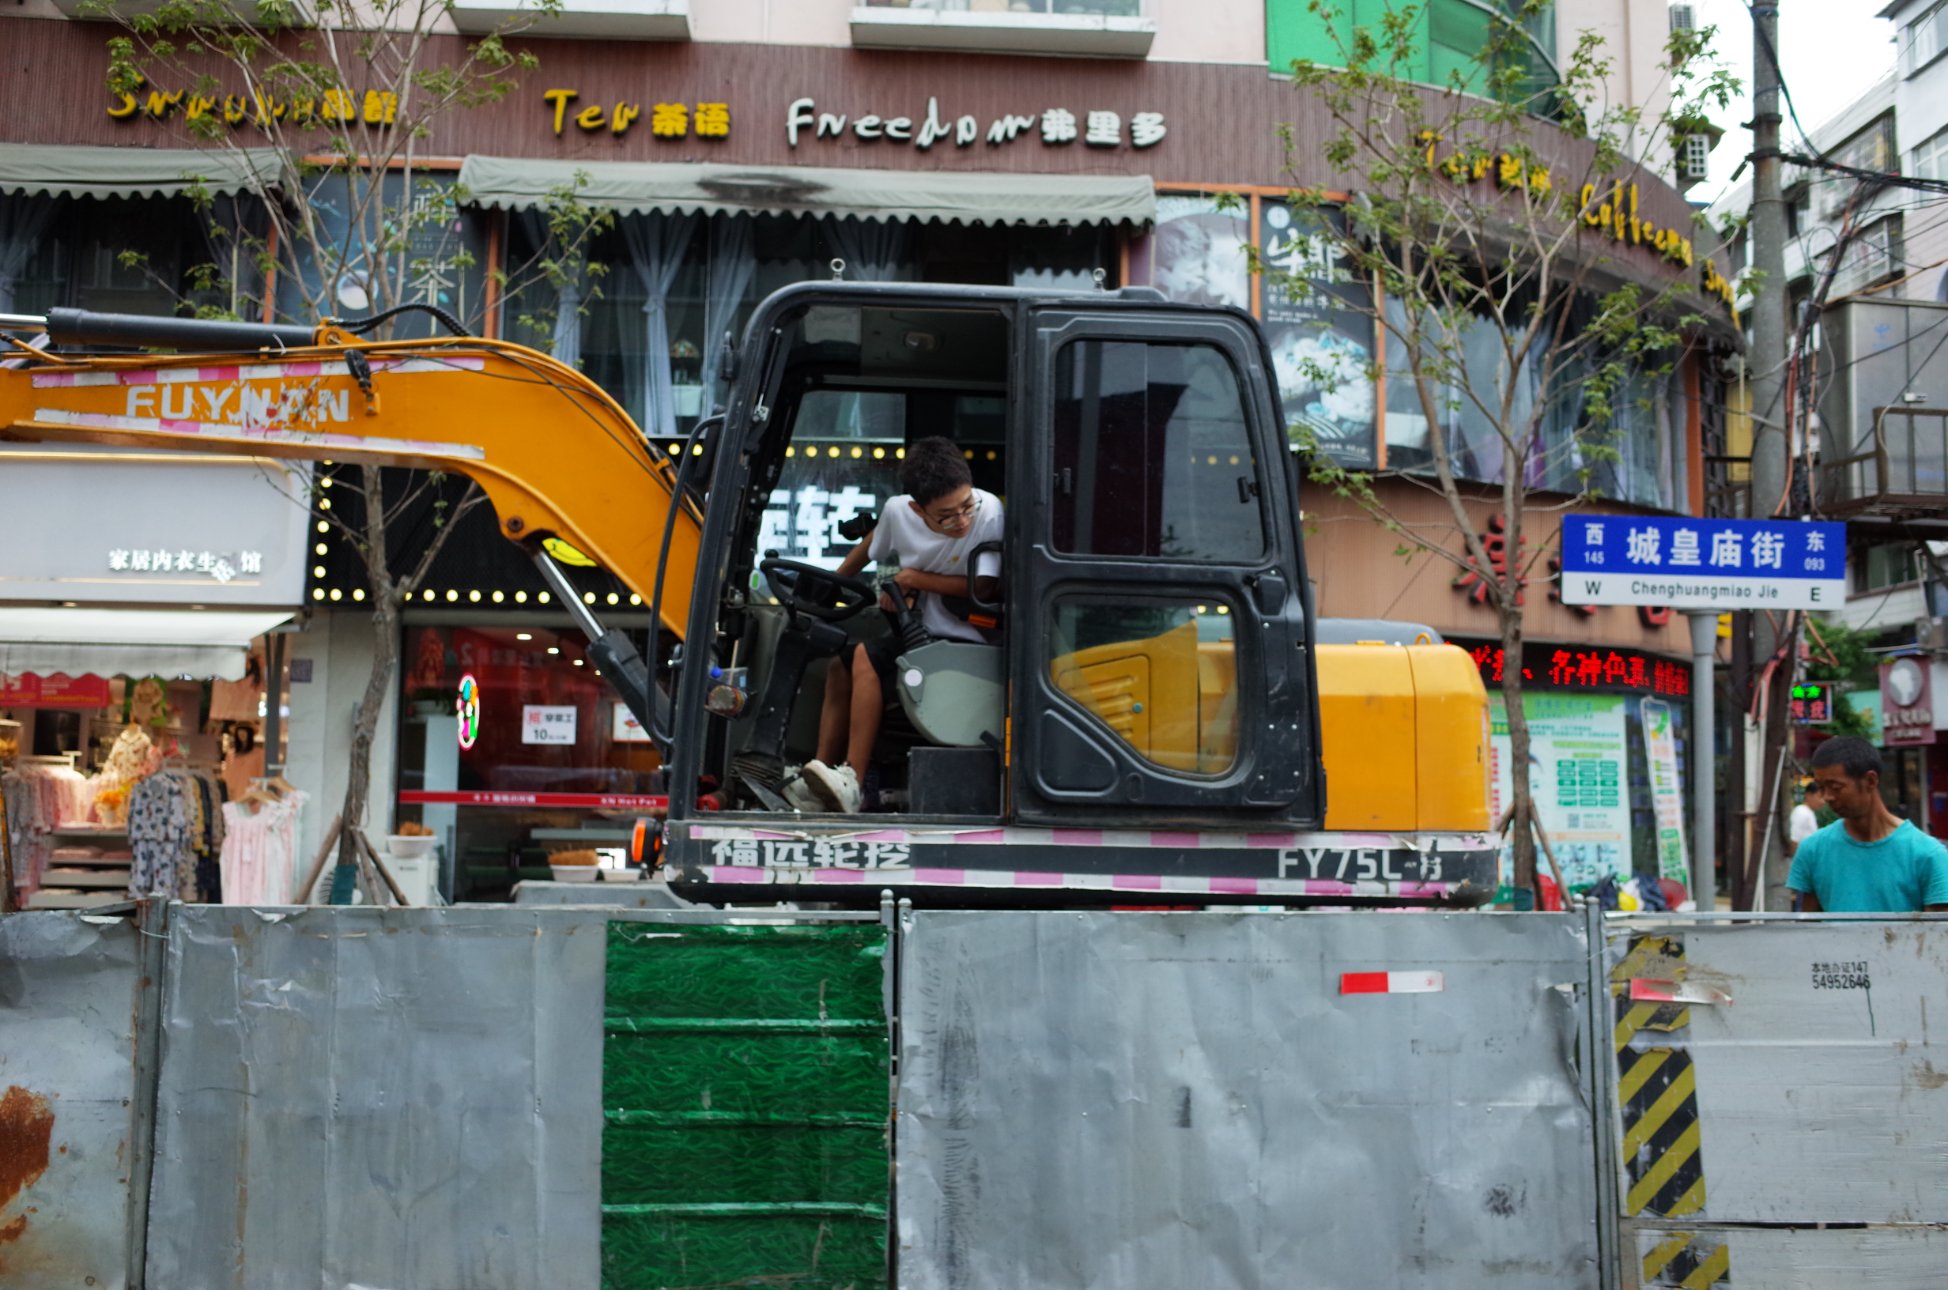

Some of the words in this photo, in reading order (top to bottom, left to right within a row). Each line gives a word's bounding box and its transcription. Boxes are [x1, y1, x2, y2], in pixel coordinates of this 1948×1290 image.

[651, 102, 731, 138] 茶语
[786, 95, 1036, 149] Freedom
[1040, 107, 1168, 148] 弗里多
[1585, 523, 1605, 546] 西
[1806, 531, 1826, 553] 东
[1584, 551, 1605, 565] 145
[1626, 527, 1786, 570] 城皇庙街
[1804, 558, 1825, 572] 093
[1585, 581, 1602, 596] W
[1631, 581, 1752, 600] Chenghuangmiao
[1758, 585, 1779, 599] Jie
[1810, 587, 1821, 602] E
[712, 839, 911, 869] 福远轮挖
[1811, 961, 1868, 974] 本地办证147
[1812, 974, 1871, 990] 54952646
